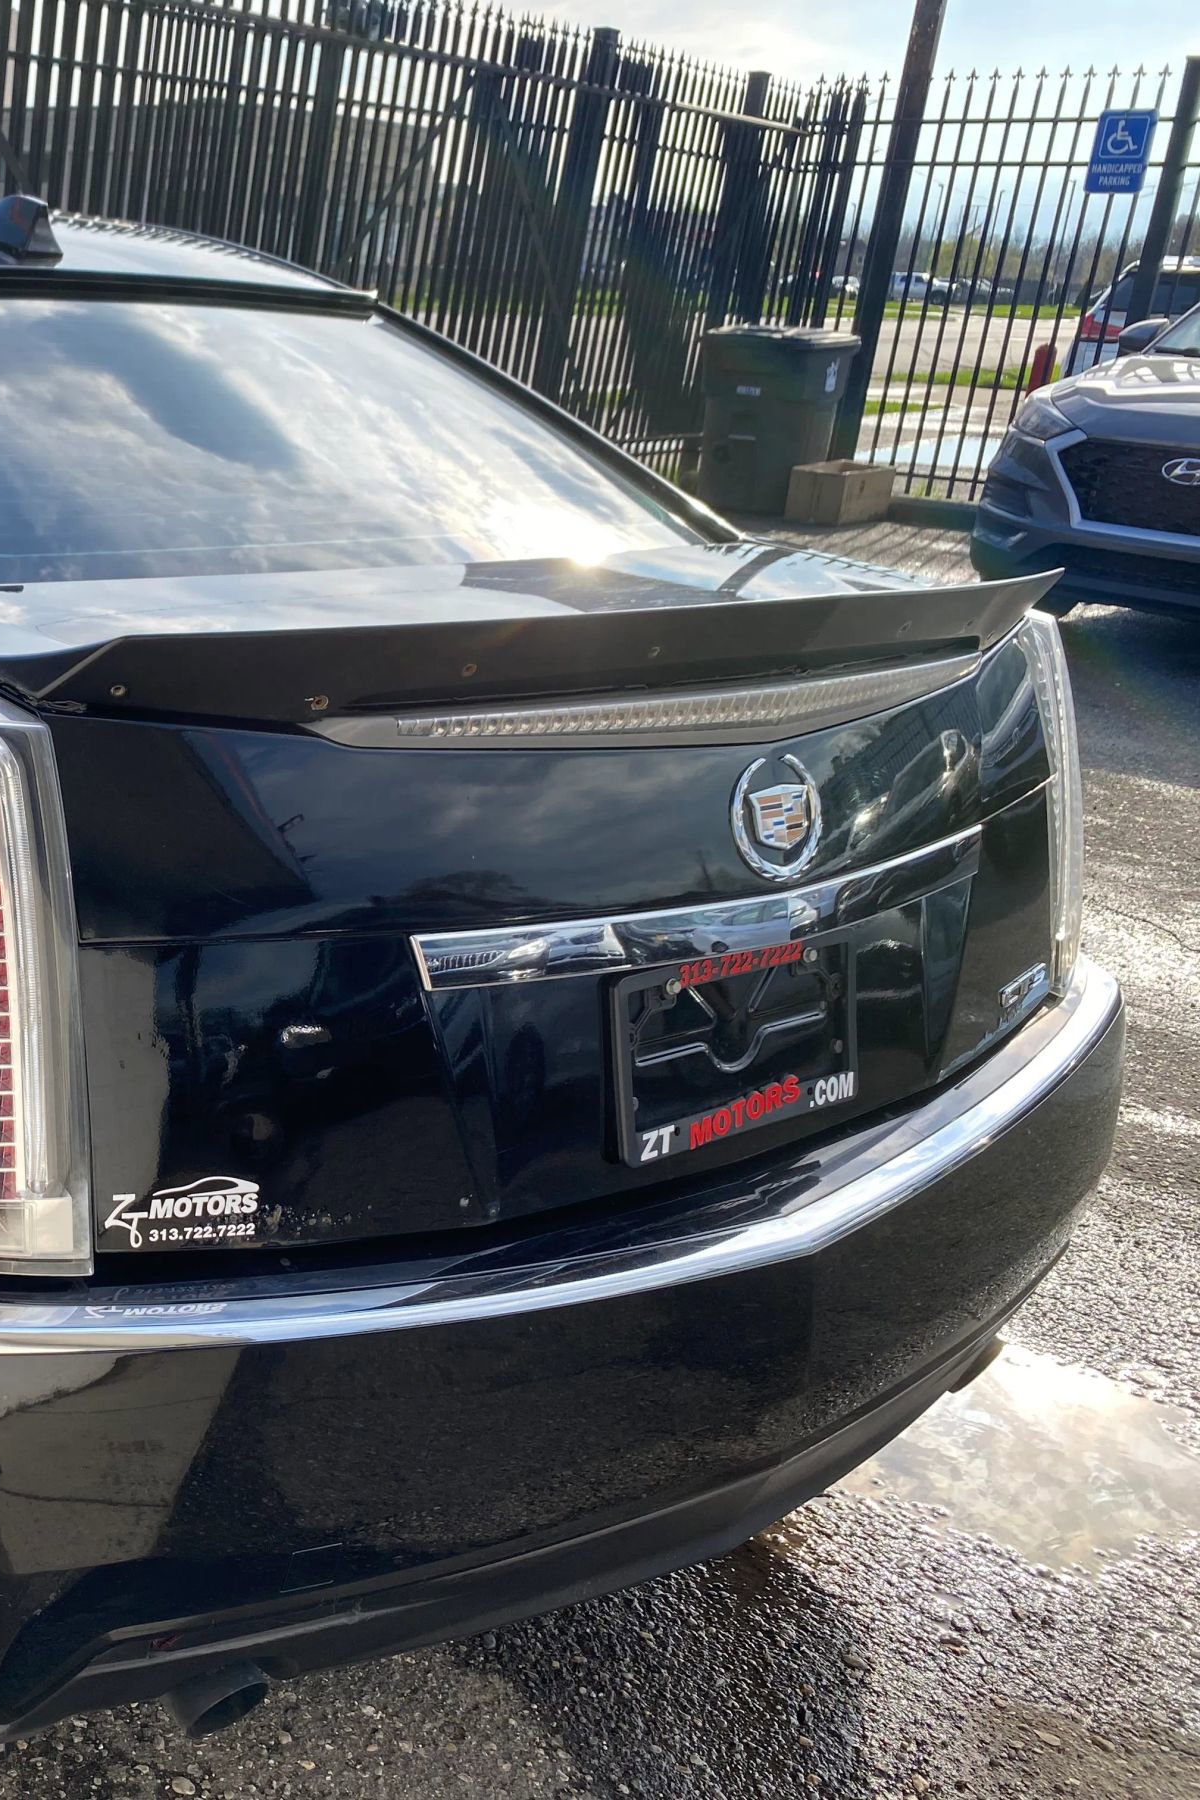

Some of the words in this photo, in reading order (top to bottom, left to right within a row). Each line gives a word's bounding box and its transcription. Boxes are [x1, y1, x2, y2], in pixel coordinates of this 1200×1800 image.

[1091, 163, 1143, 174] HANDICAPPED
[1098, 176, 1131, 186] PARKING
[679, 942, 803, 988] 313-722-7222
[640, 1125, 675, 1161] ZT
[689, 1074, 801, 1150] MOTORS
[149, 1192, 258, 1219] MOTORS
[149, 1223, 255, 1242] 313.722.7222
